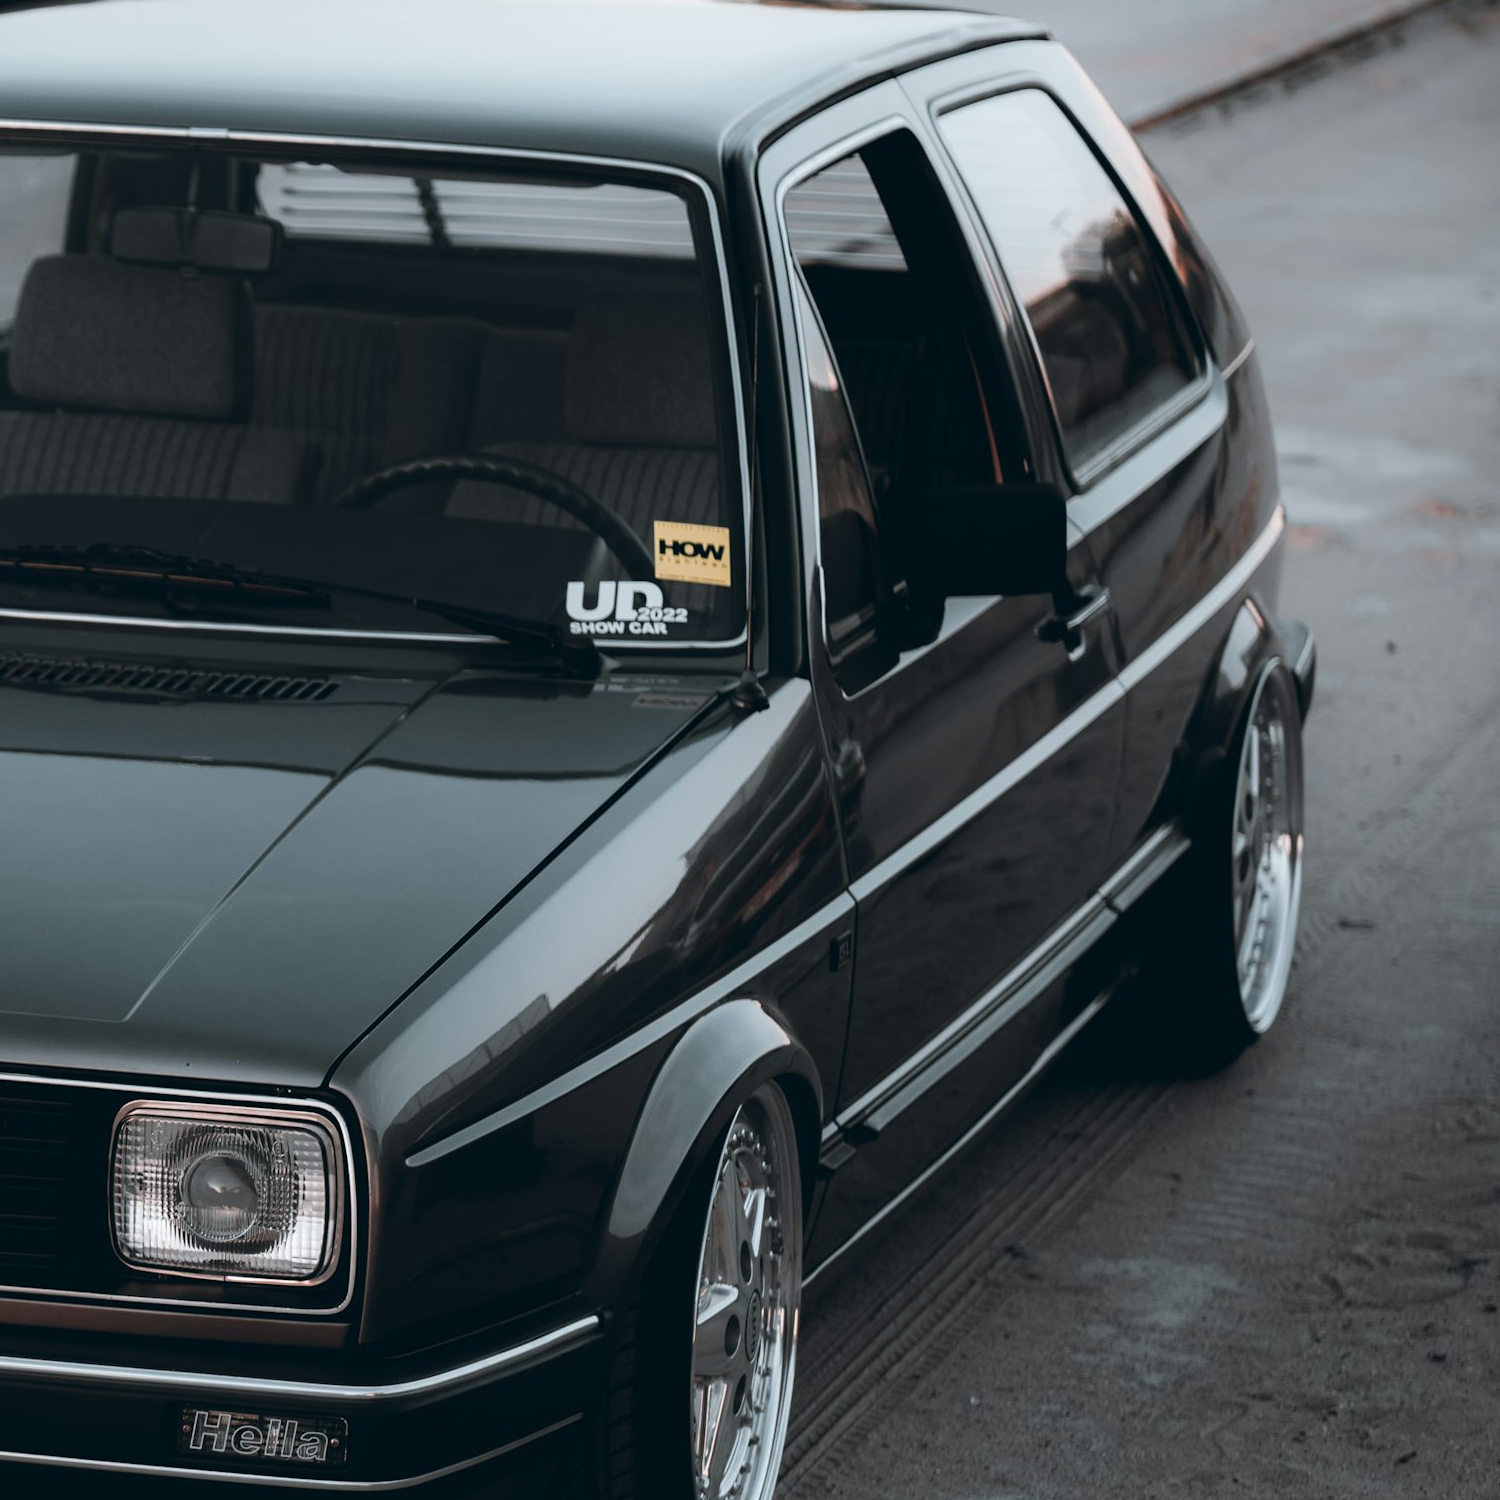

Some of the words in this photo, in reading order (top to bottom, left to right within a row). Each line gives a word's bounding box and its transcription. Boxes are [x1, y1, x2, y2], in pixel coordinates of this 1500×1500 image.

[660, 539, 725, 561] HOW
[566, 581, 663, 621] UD
[637, 607, 688, 623] 2022
[570, 621, 625, 634] SHOW
[629, 622, 668, 635] CAR
[190, 1411, 329, 1461] Hella
